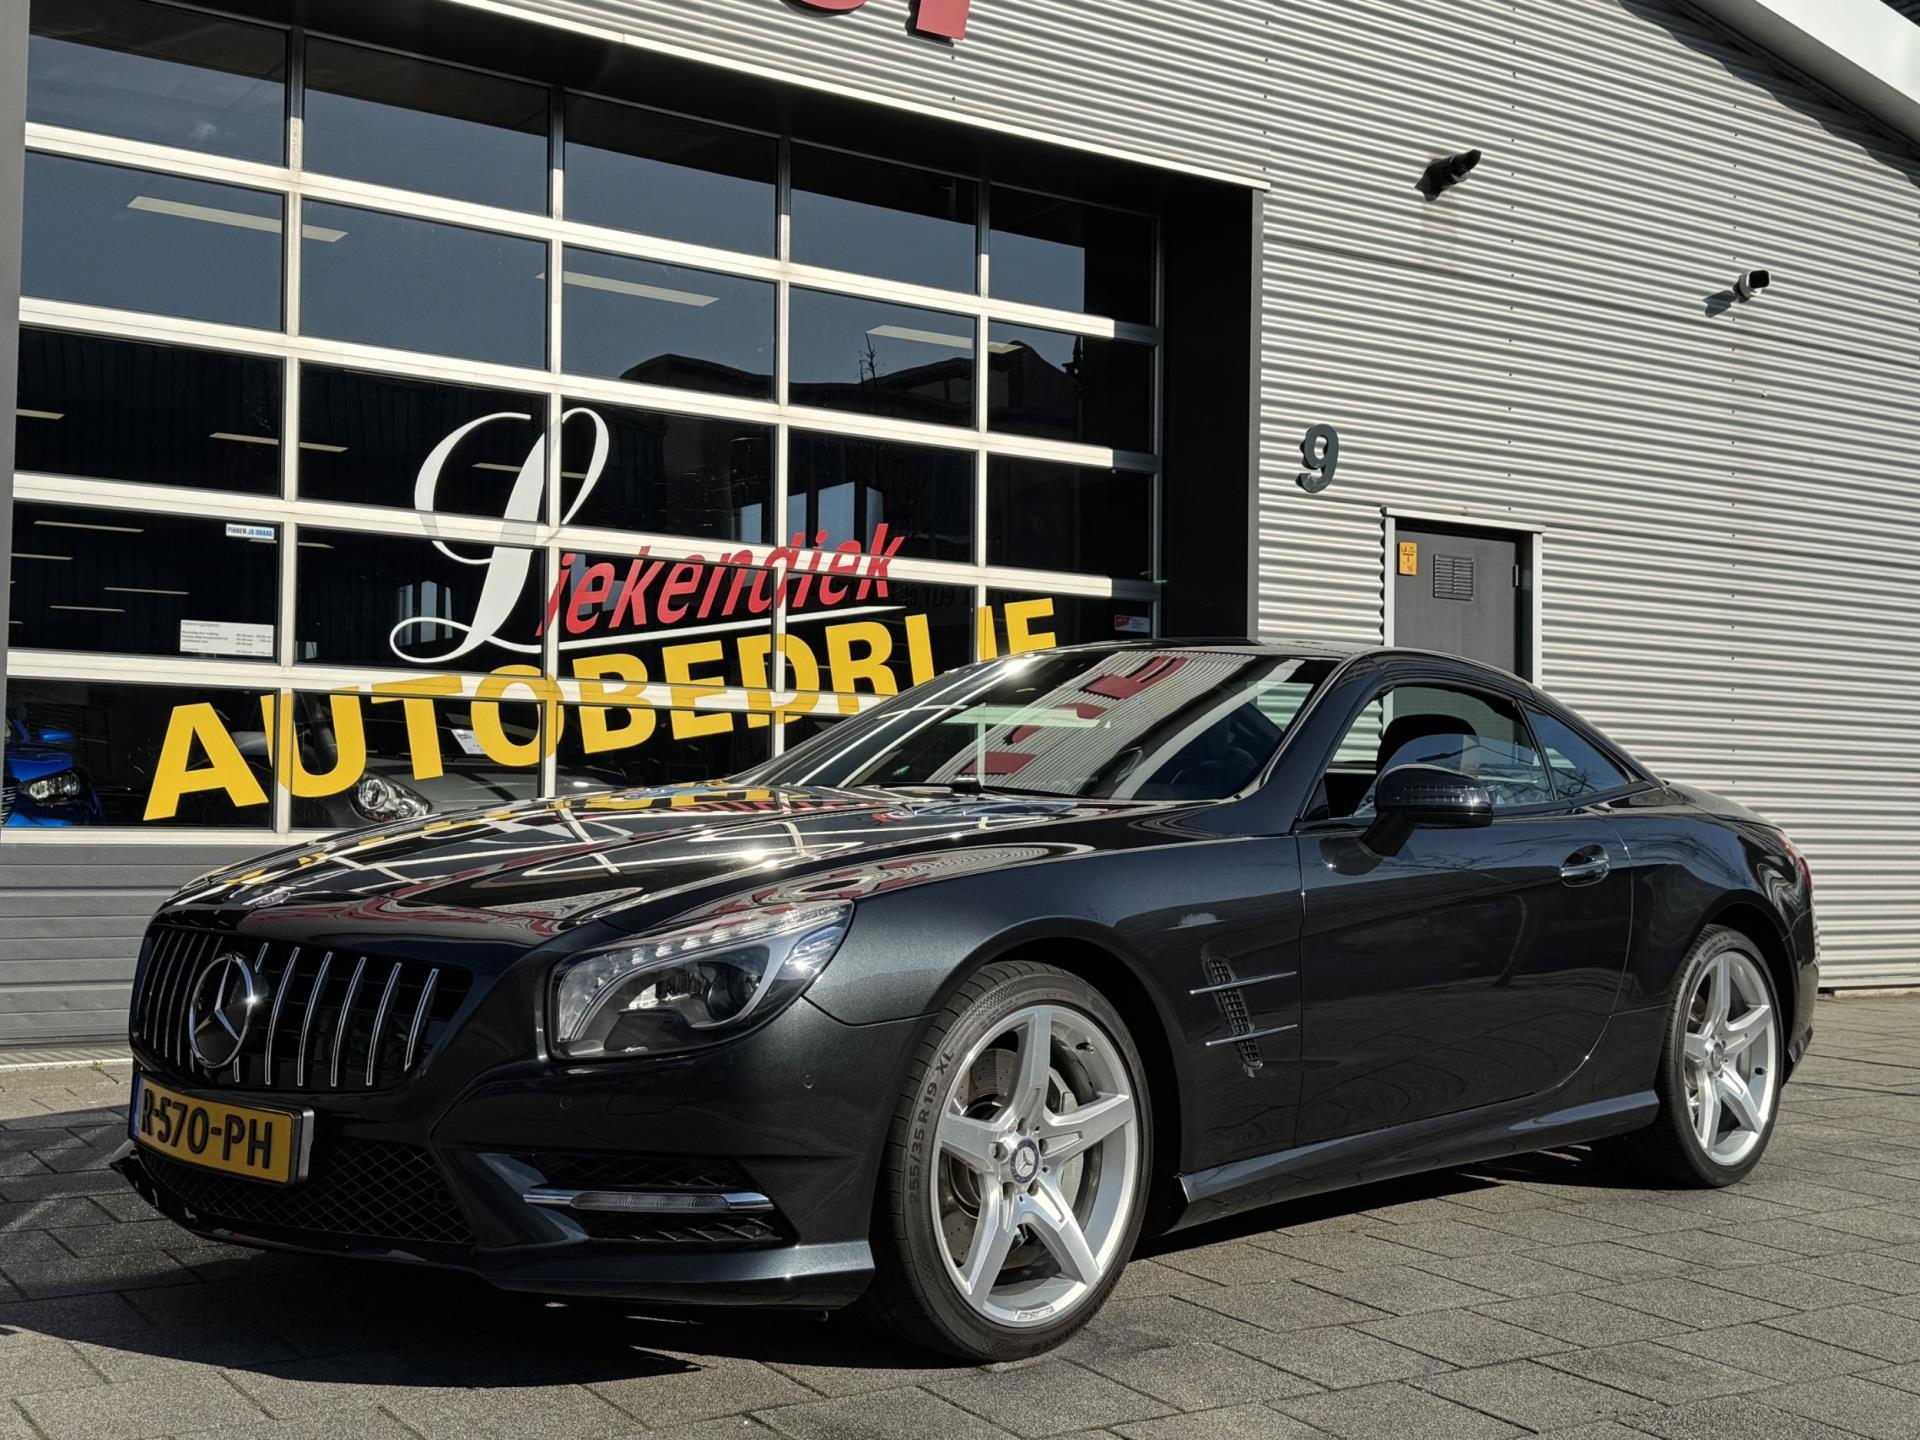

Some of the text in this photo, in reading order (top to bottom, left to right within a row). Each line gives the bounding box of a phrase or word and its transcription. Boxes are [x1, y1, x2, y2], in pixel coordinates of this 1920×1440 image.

[1297, 424, 1339, 493] 9
[935, 1052, 955, 1076] XL
[141, 1088, 273, 1170] R-570-PH
